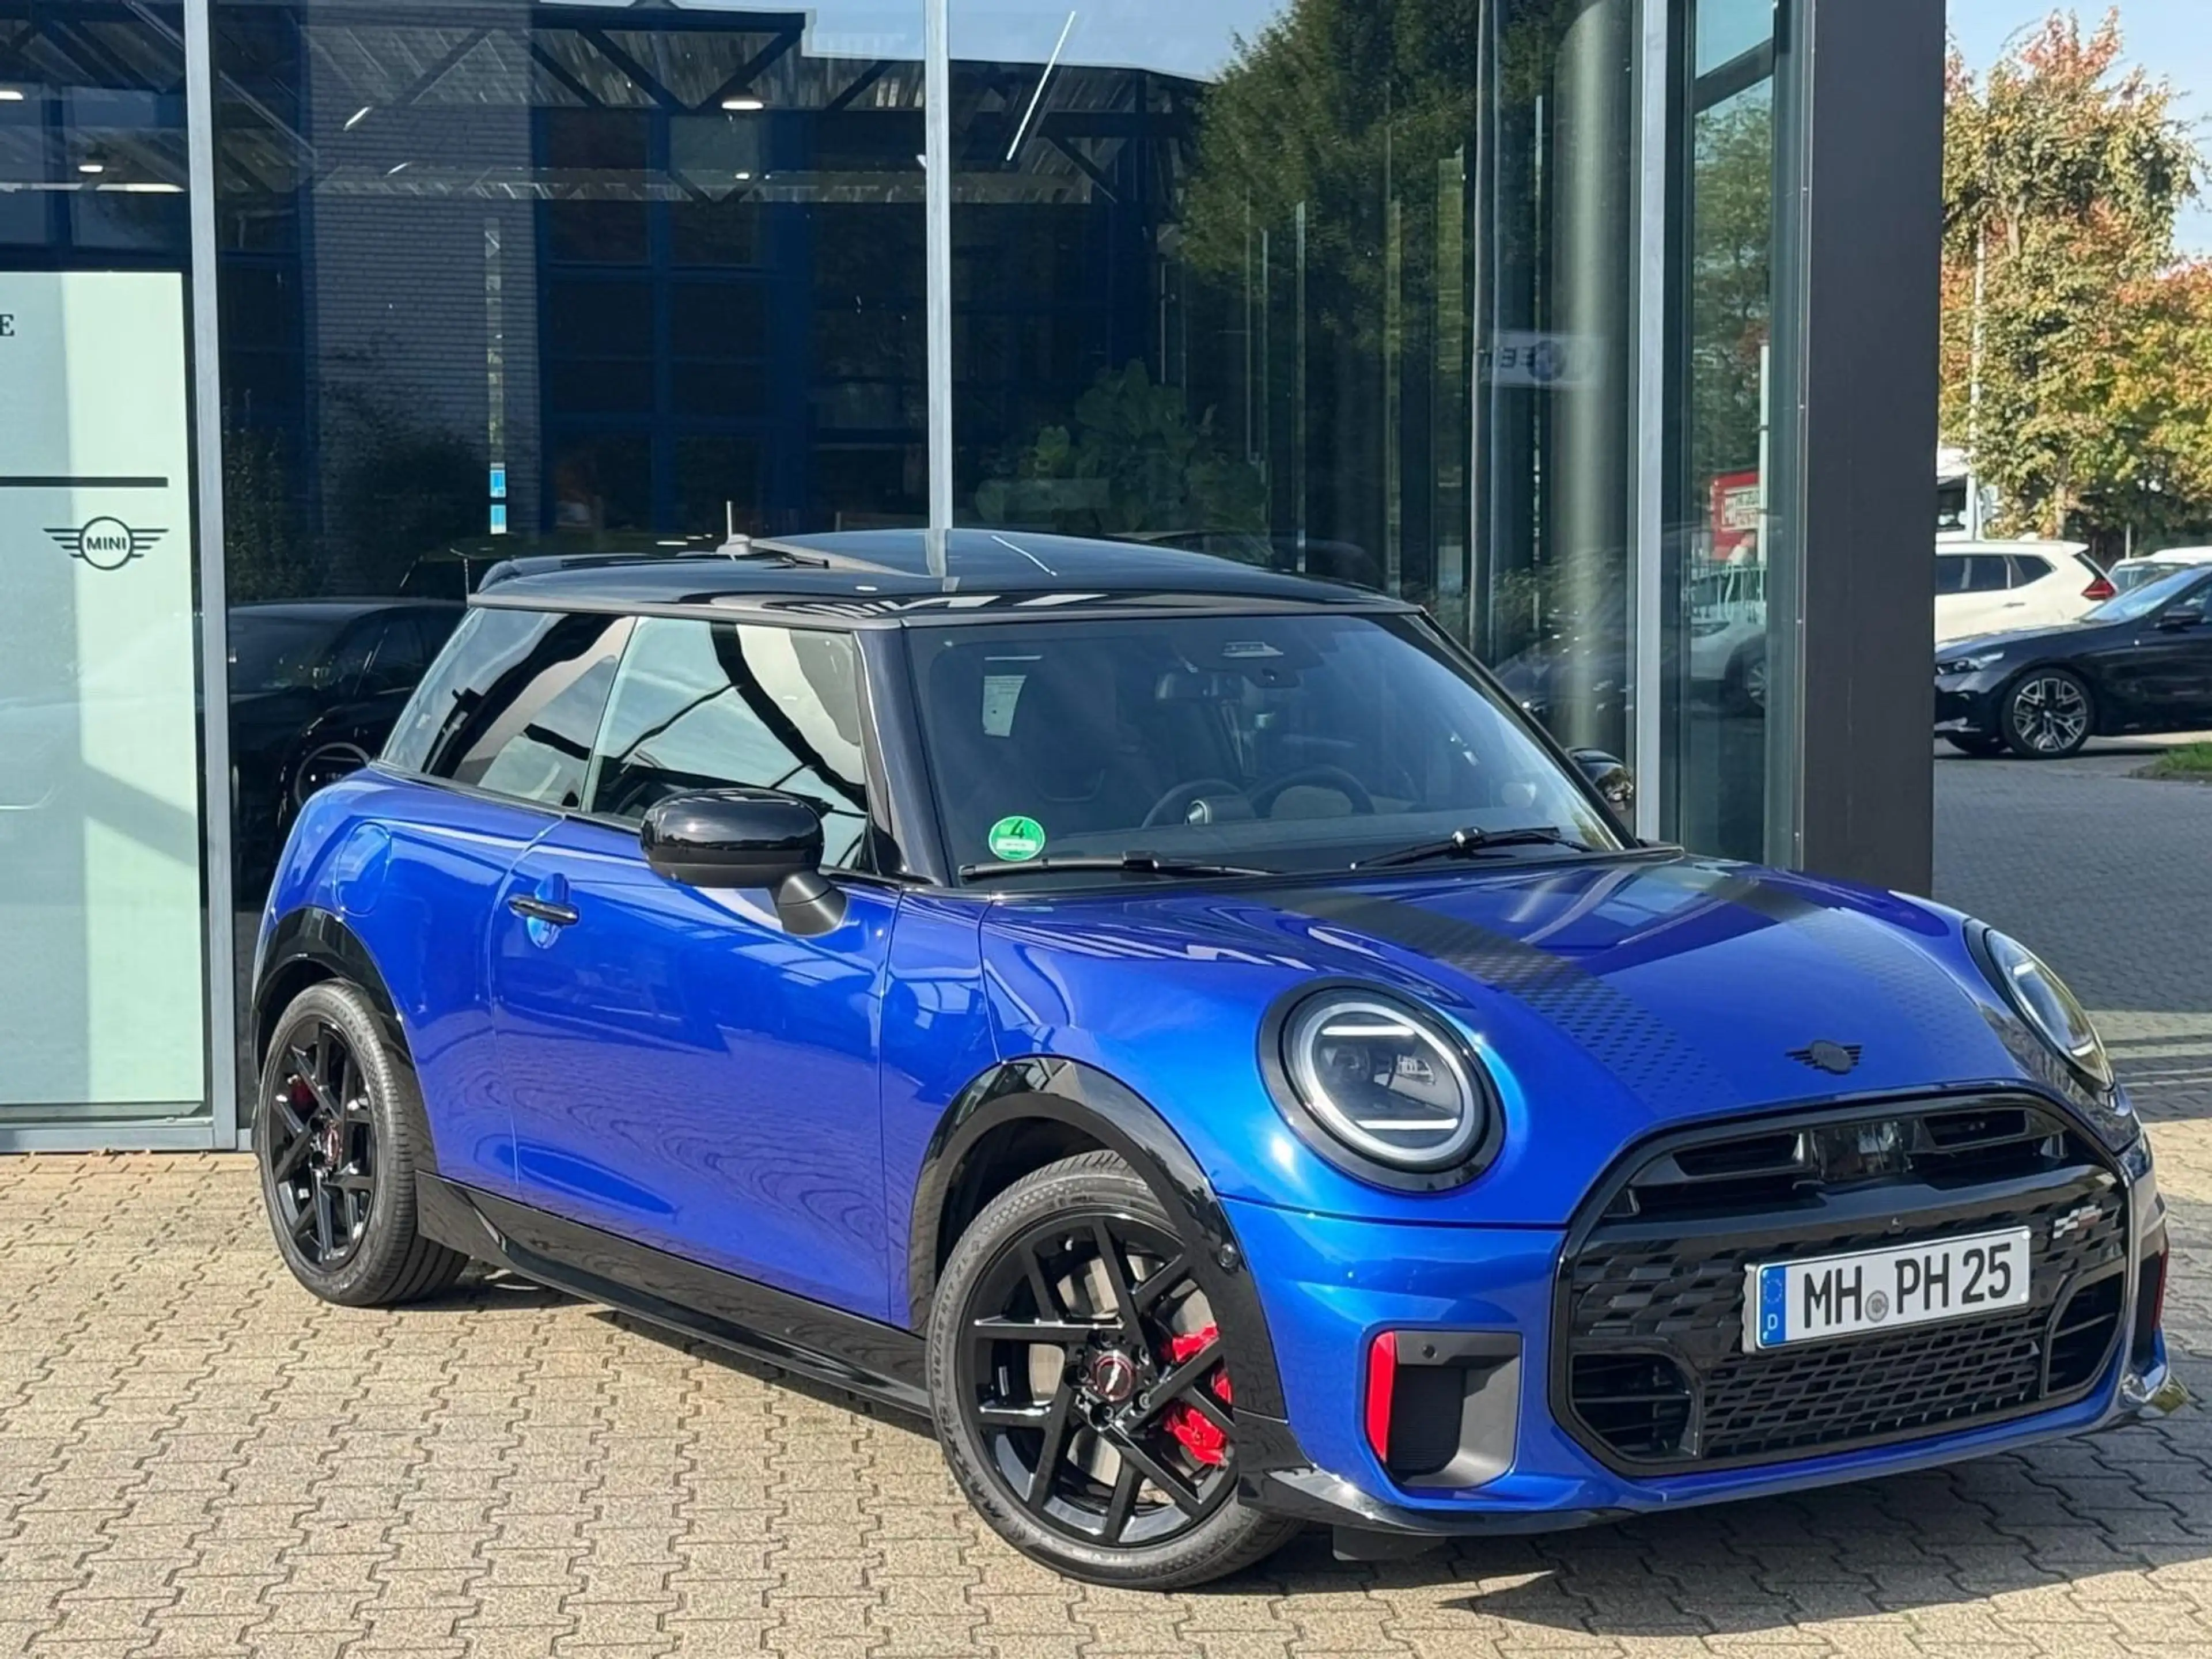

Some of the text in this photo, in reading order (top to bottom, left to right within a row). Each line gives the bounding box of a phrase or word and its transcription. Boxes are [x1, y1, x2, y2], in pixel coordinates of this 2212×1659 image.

[87, 537, 126, 550] MINI
[1010, 819, 1024, 839] 4
[1804, 1242, 2012, 1328] MH PH 25
[1767, 1313, 1777, 1330] D
